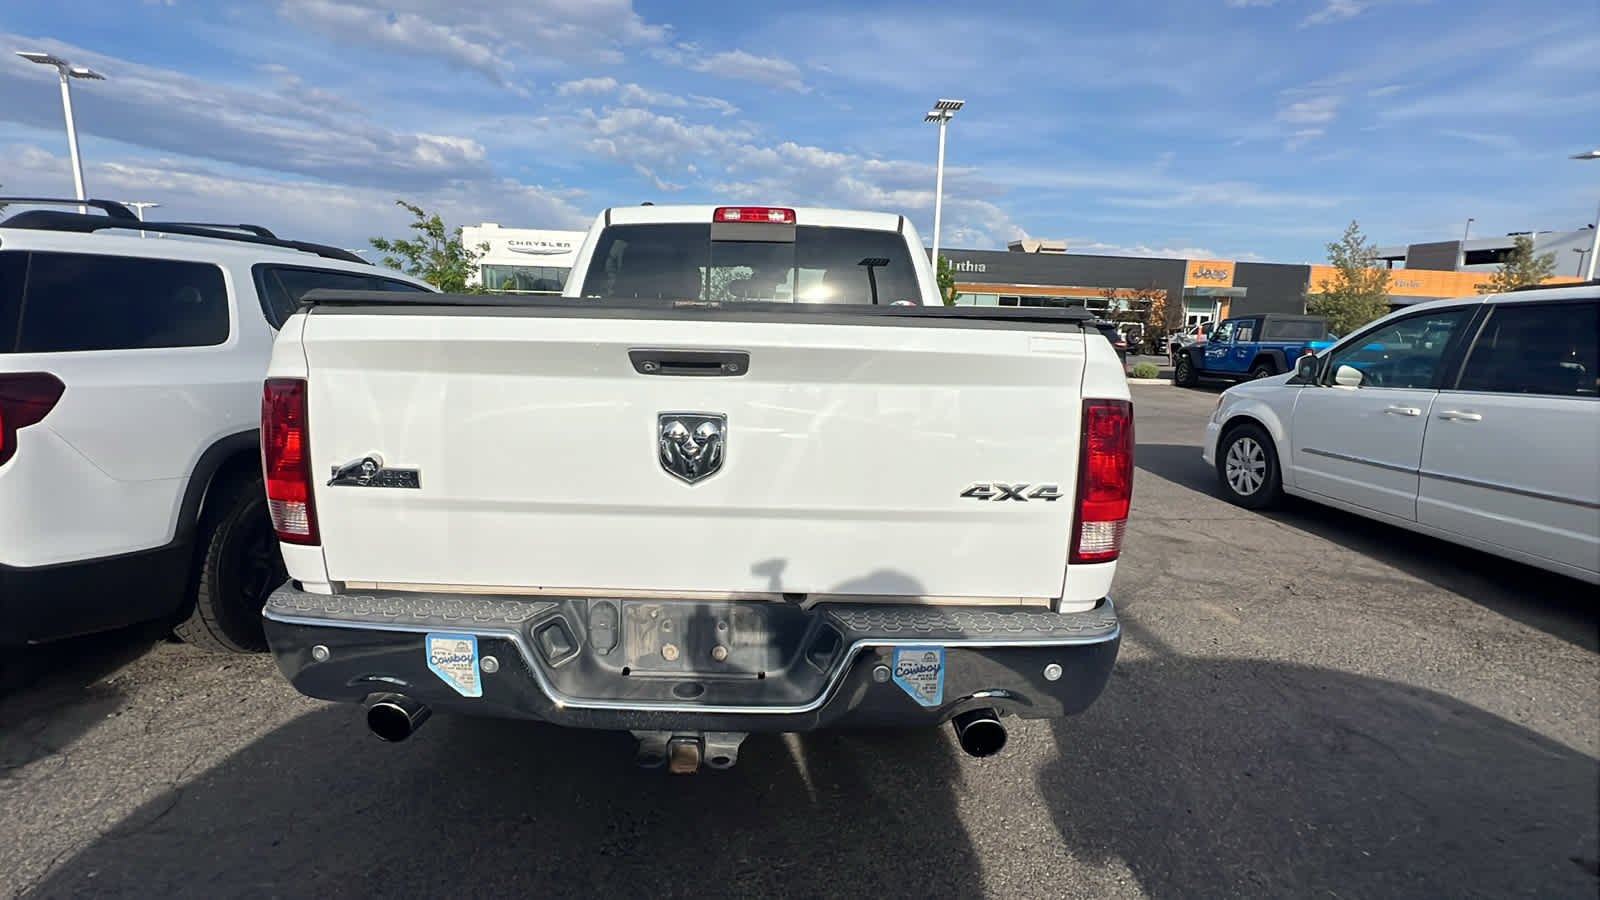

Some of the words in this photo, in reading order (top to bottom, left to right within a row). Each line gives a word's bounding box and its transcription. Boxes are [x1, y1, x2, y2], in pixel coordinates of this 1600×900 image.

[508, 240, 571, 248] CHRYSLER
[1193, 264, 1228, 281] Jeep
[430, 654, 475, 665] Cowboy
[895, 664, 941, 677] Cowboy
